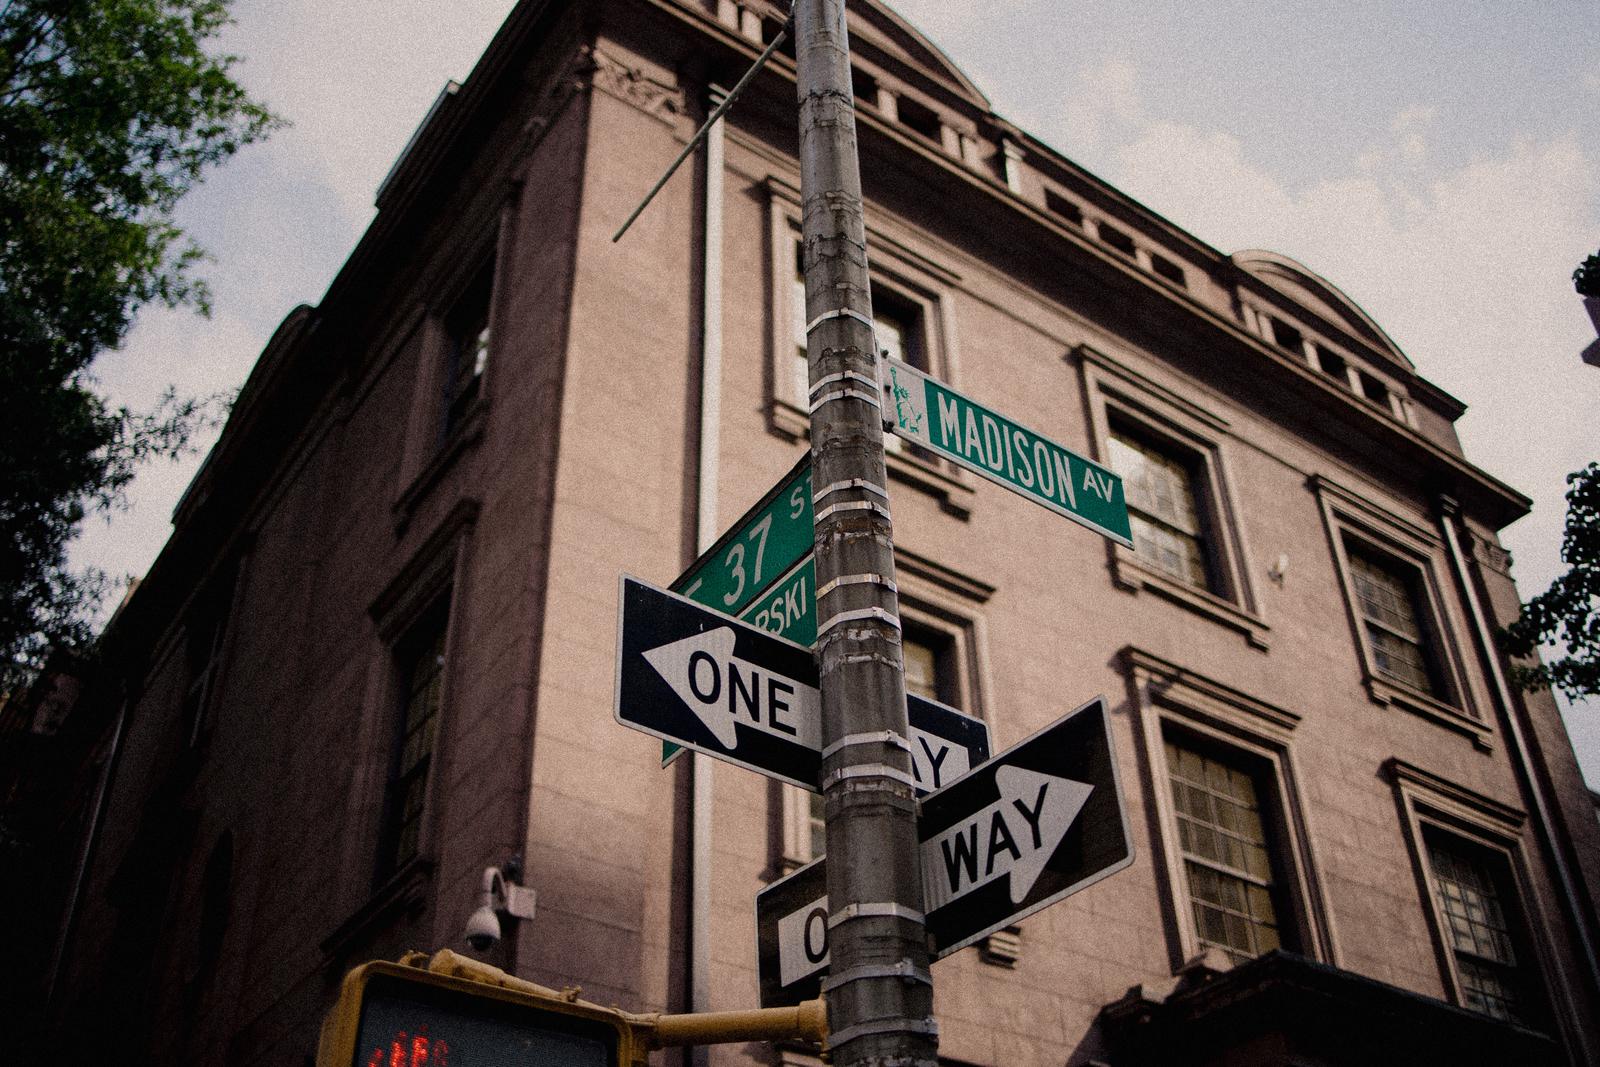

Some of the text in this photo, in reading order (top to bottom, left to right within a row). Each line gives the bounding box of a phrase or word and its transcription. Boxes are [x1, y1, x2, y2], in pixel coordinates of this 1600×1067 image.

[937, 391, 1114, 510] MADISON AV
[723, 474, 814, 606] 37 S
[688, 650, 797, 737] ONE
[941, 782, 1049, 894] WAY
